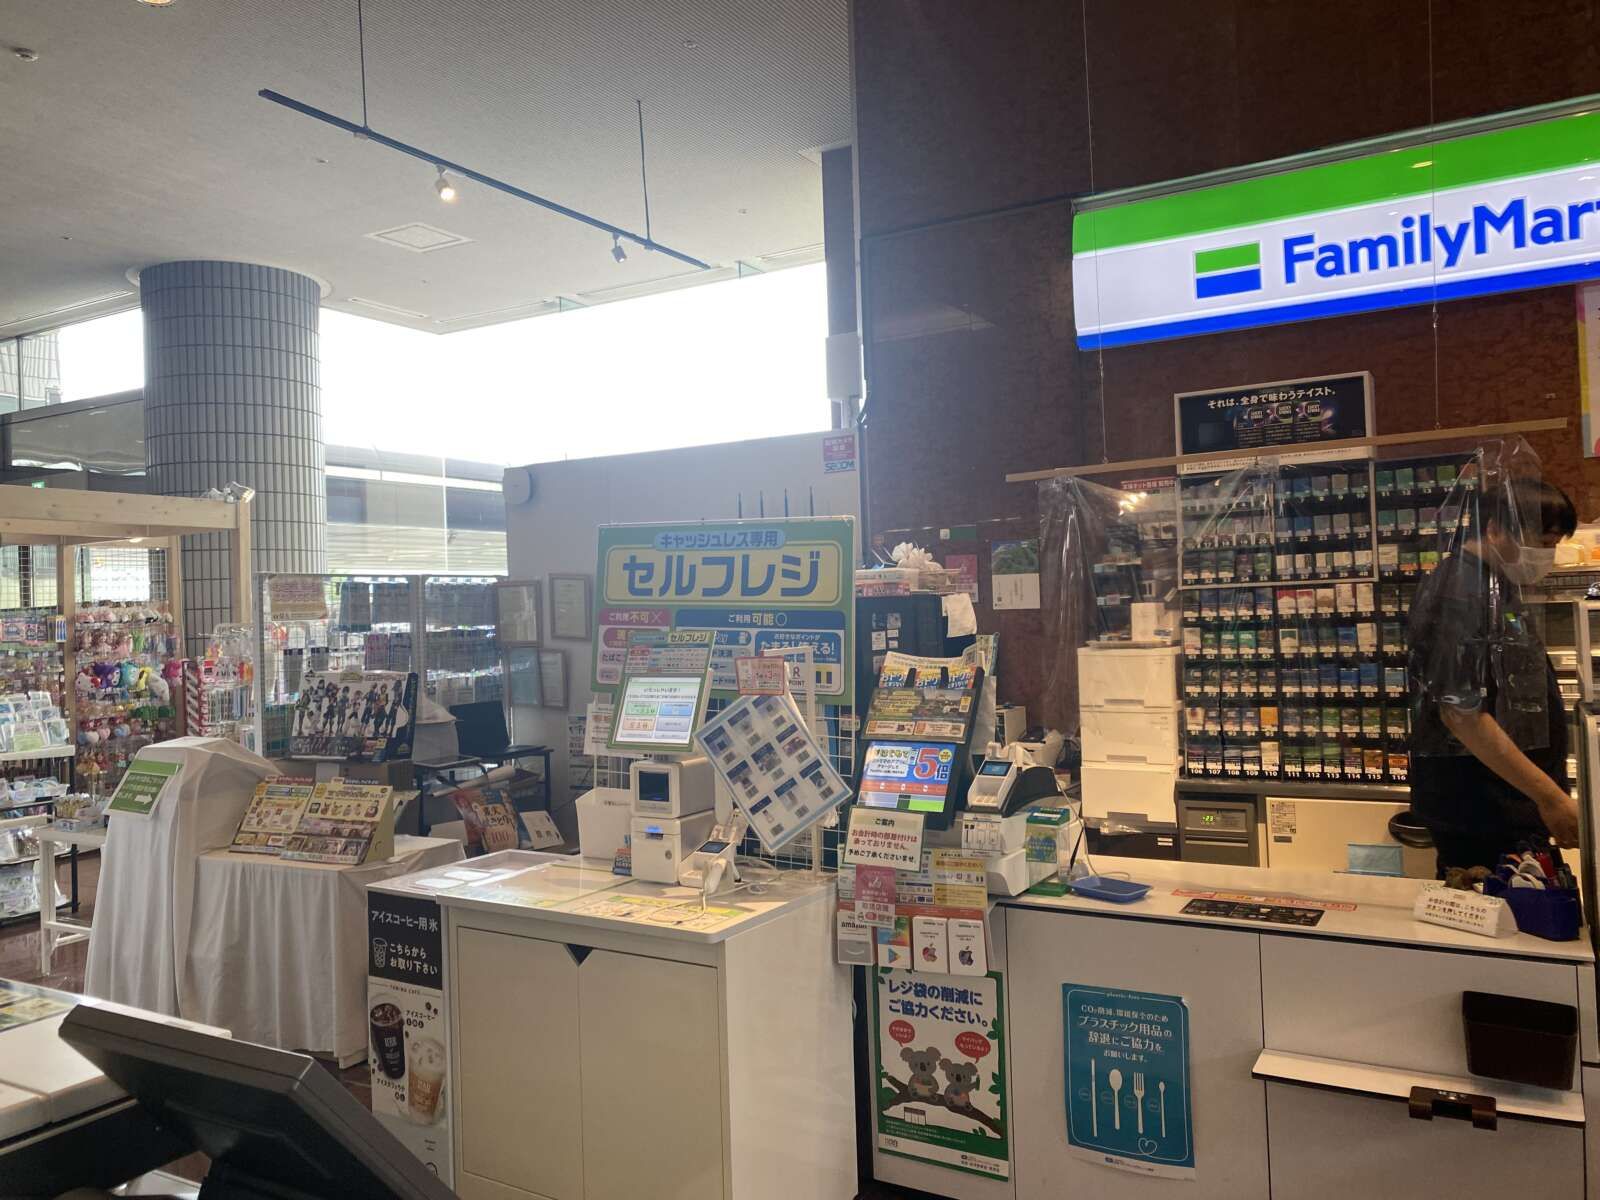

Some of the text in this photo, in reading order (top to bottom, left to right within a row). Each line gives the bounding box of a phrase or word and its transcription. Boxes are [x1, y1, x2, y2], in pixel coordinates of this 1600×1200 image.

[1283, 196, 1600, 284] FamilyMar
[824, 460, 855, 473] SECOM
[660, 532, 778, 548] キャッシュレス専用
[623, 551, 821, 597] セルフレジ
[608, 611, 650, 624] ご利用不可
[728, 612, 774, 626] ご利用可能
[670, 632, 707, 642] セルフレジ
[875, 818, 896, 827] ご案内
[372, 910, 438, 932] アイスコーヒー用氷
[389, 943, 427, 959] こちらから
[390, 958, 438, 975] お取り下さい
[888, 980, 983, 1004] レジ袋の削減に
[406, 1010, 436, 1020] アイスコーヒー
[888, 999, 988, 1028] ご協力ください。
[1078, 1016, 1172, 1037] プラスチック用品の
[1088, 1031, 1165, 1054] 辞退にご協力を
[1104, 1049, 1148, 1063] お願いします。
